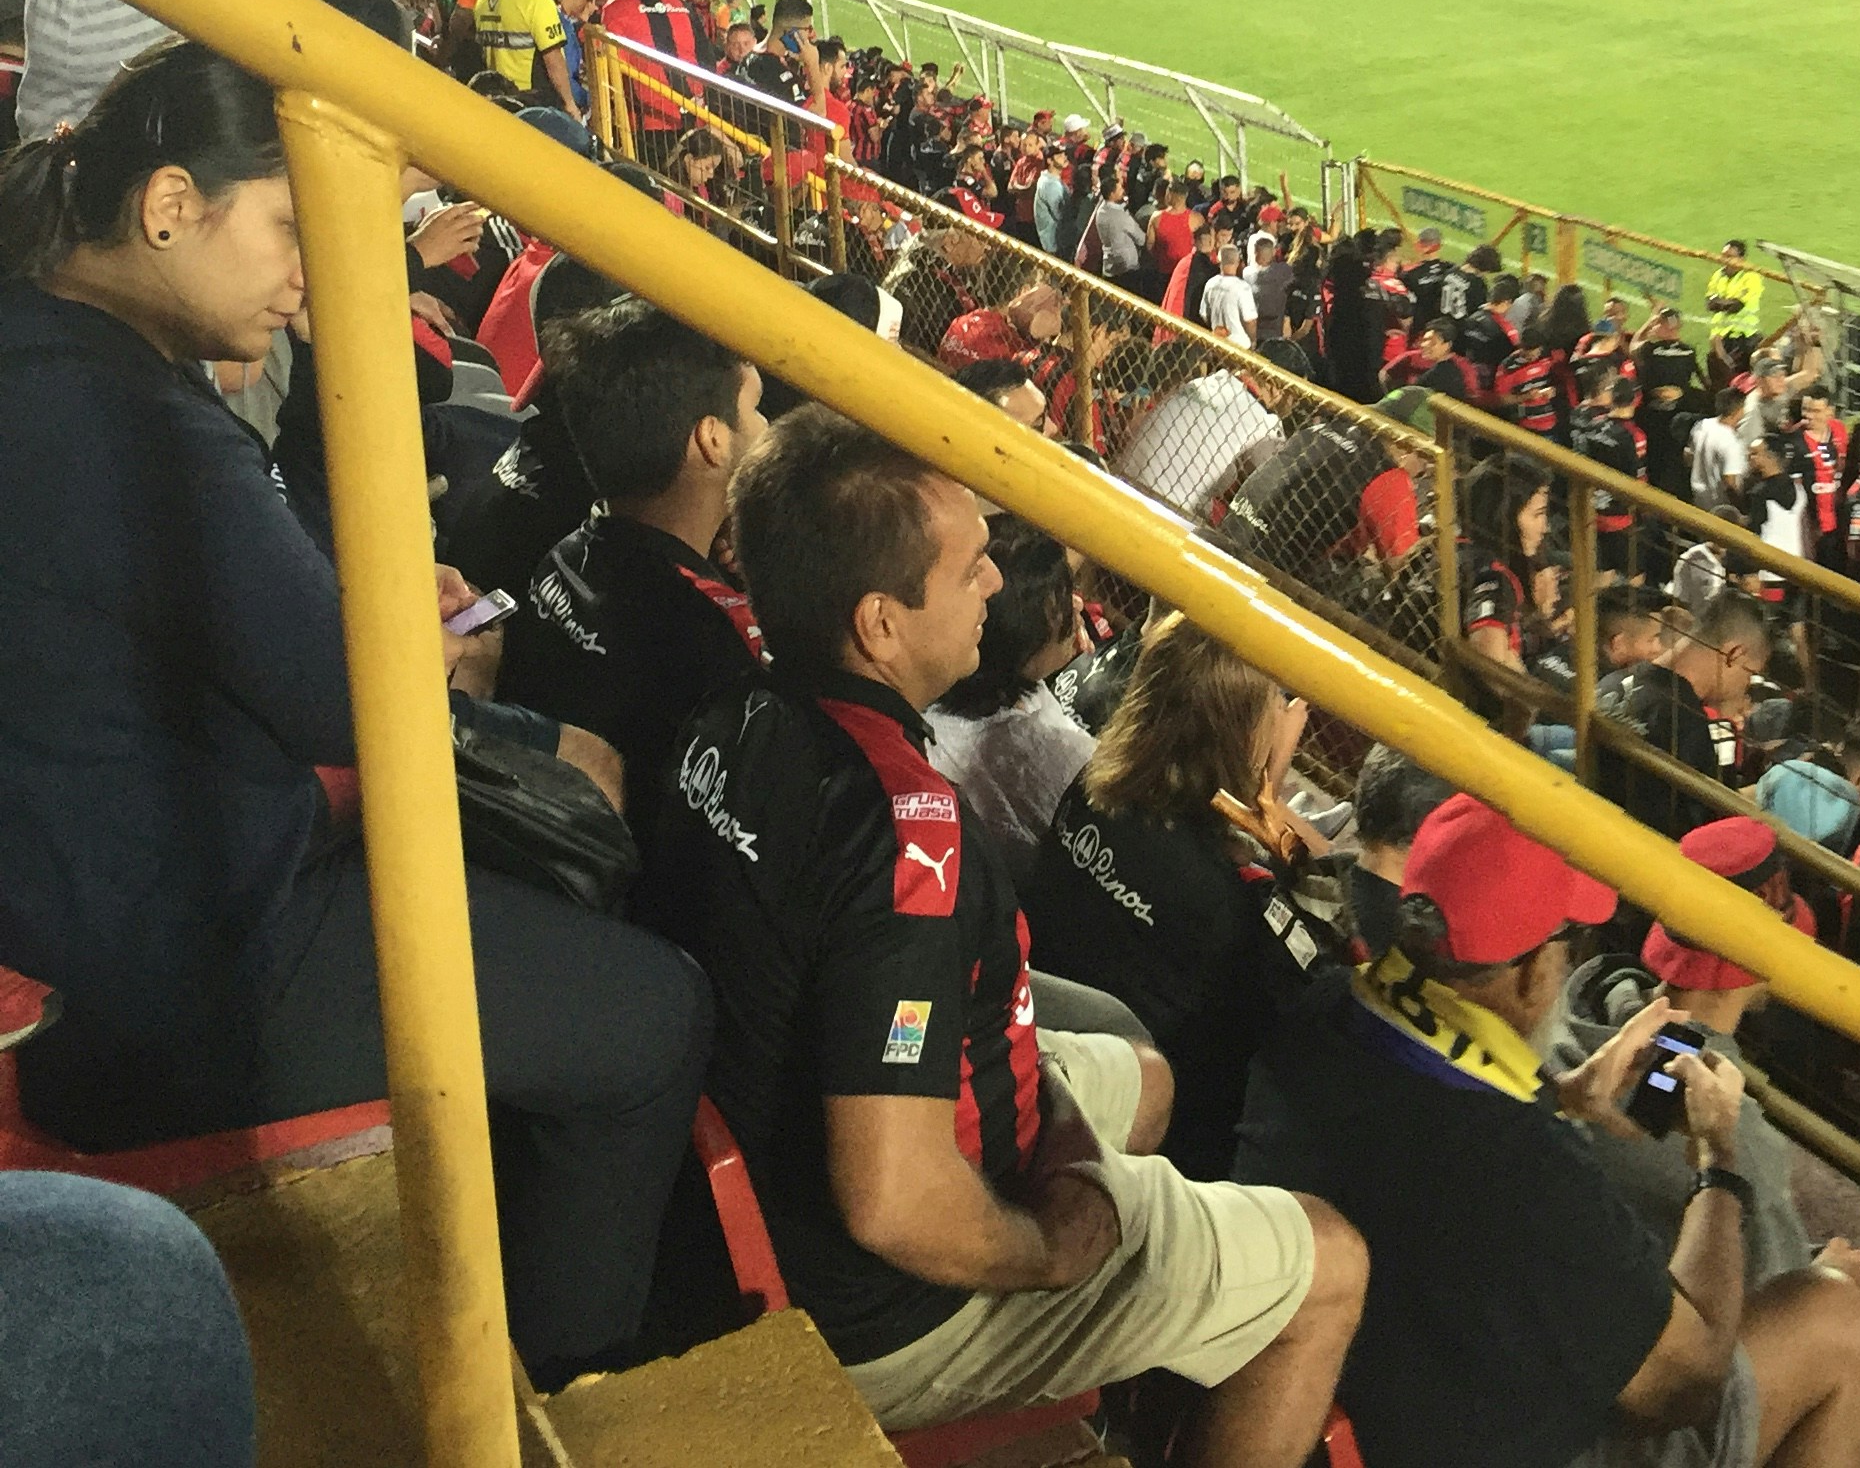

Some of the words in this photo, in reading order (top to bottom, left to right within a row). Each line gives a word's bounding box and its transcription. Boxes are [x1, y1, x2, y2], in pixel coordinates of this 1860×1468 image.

[703, 769, 759, 863] Pinos
[893, 793, 955, 808] GRUPO
[1093, 847, 1154, 928] Pinos
[886, 1042, 921, 1058] FPD
